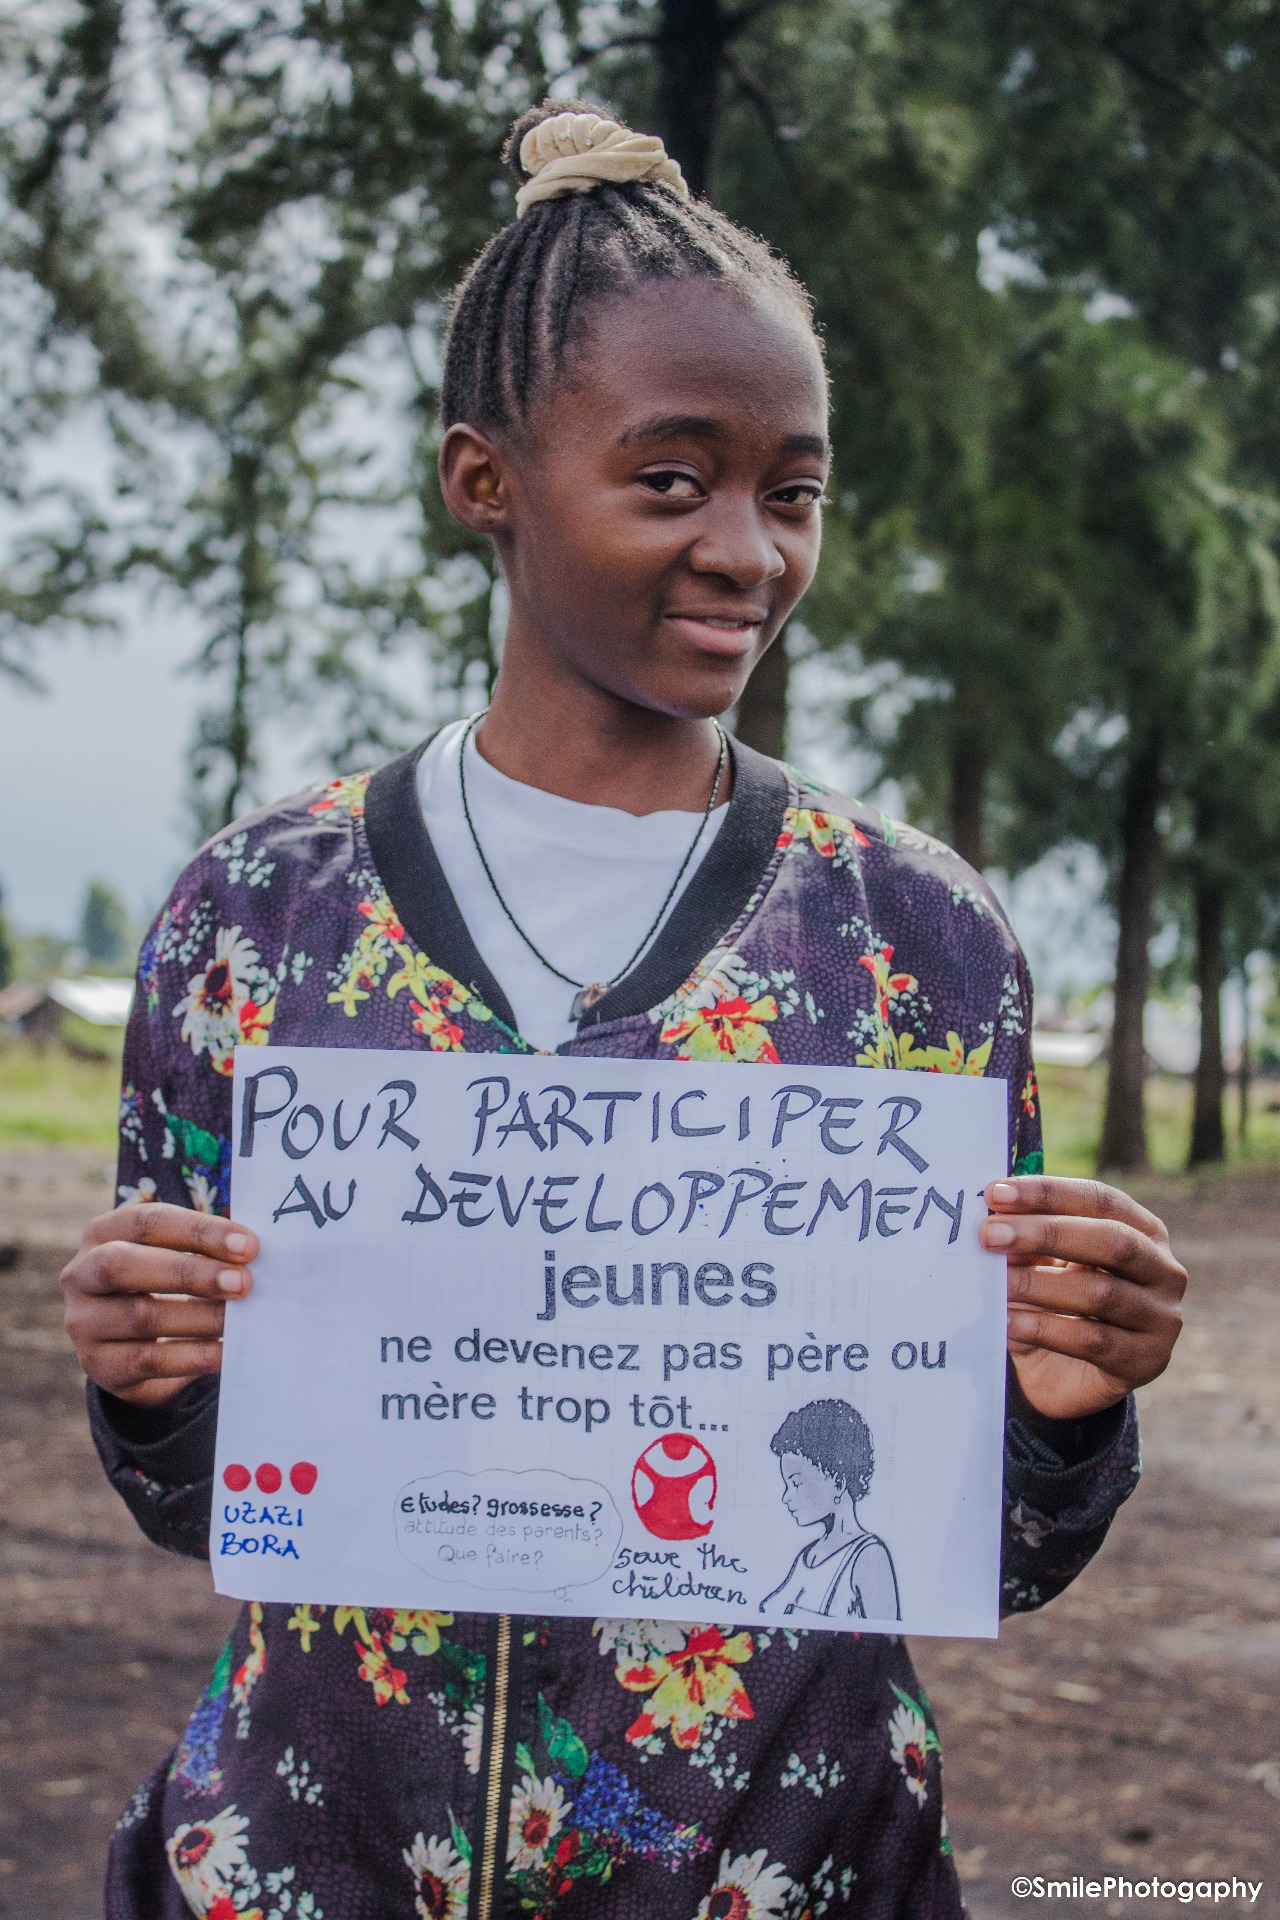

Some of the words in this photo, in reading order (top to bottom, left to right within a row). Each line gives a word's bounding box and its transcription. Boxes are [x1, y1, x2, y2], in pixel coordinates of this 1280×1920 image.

[238, 1065, 421, 1160] POUR
[465, 1075, 930, 1174] PARTICIPER
[272, 1173, 357, 1229] AU
[400, 1162, 985, 1246] DEVELOPPEMEN
[536, 1249, 778, 1322] jeunes
[380, 1335, 432, 1363] ne
[454, 1327, 640, 1371] devenez
[663, 1341, 743, 1382] pas
[767, 1331, 870, 1381] père
[891, 1340, 947, 1371] ou
[381, 1381, 497, 1421] mère
[517, 1386, 611, 1433] trop
[224, 1501, 304, 1527] UZAZI
[403, 1516, 478, 1537] attitude
[487, 1518, 517, 1537] des
[522, 1520, 603, 1547] parents?
[220, 1531, 300, 1560] BORA
[437, 1544, 478, 1565] Que
[485, 1542, 544, 1571] faire?
[696, 1542, 748, 1574] the
[612, 1567, 748, 1605] children
